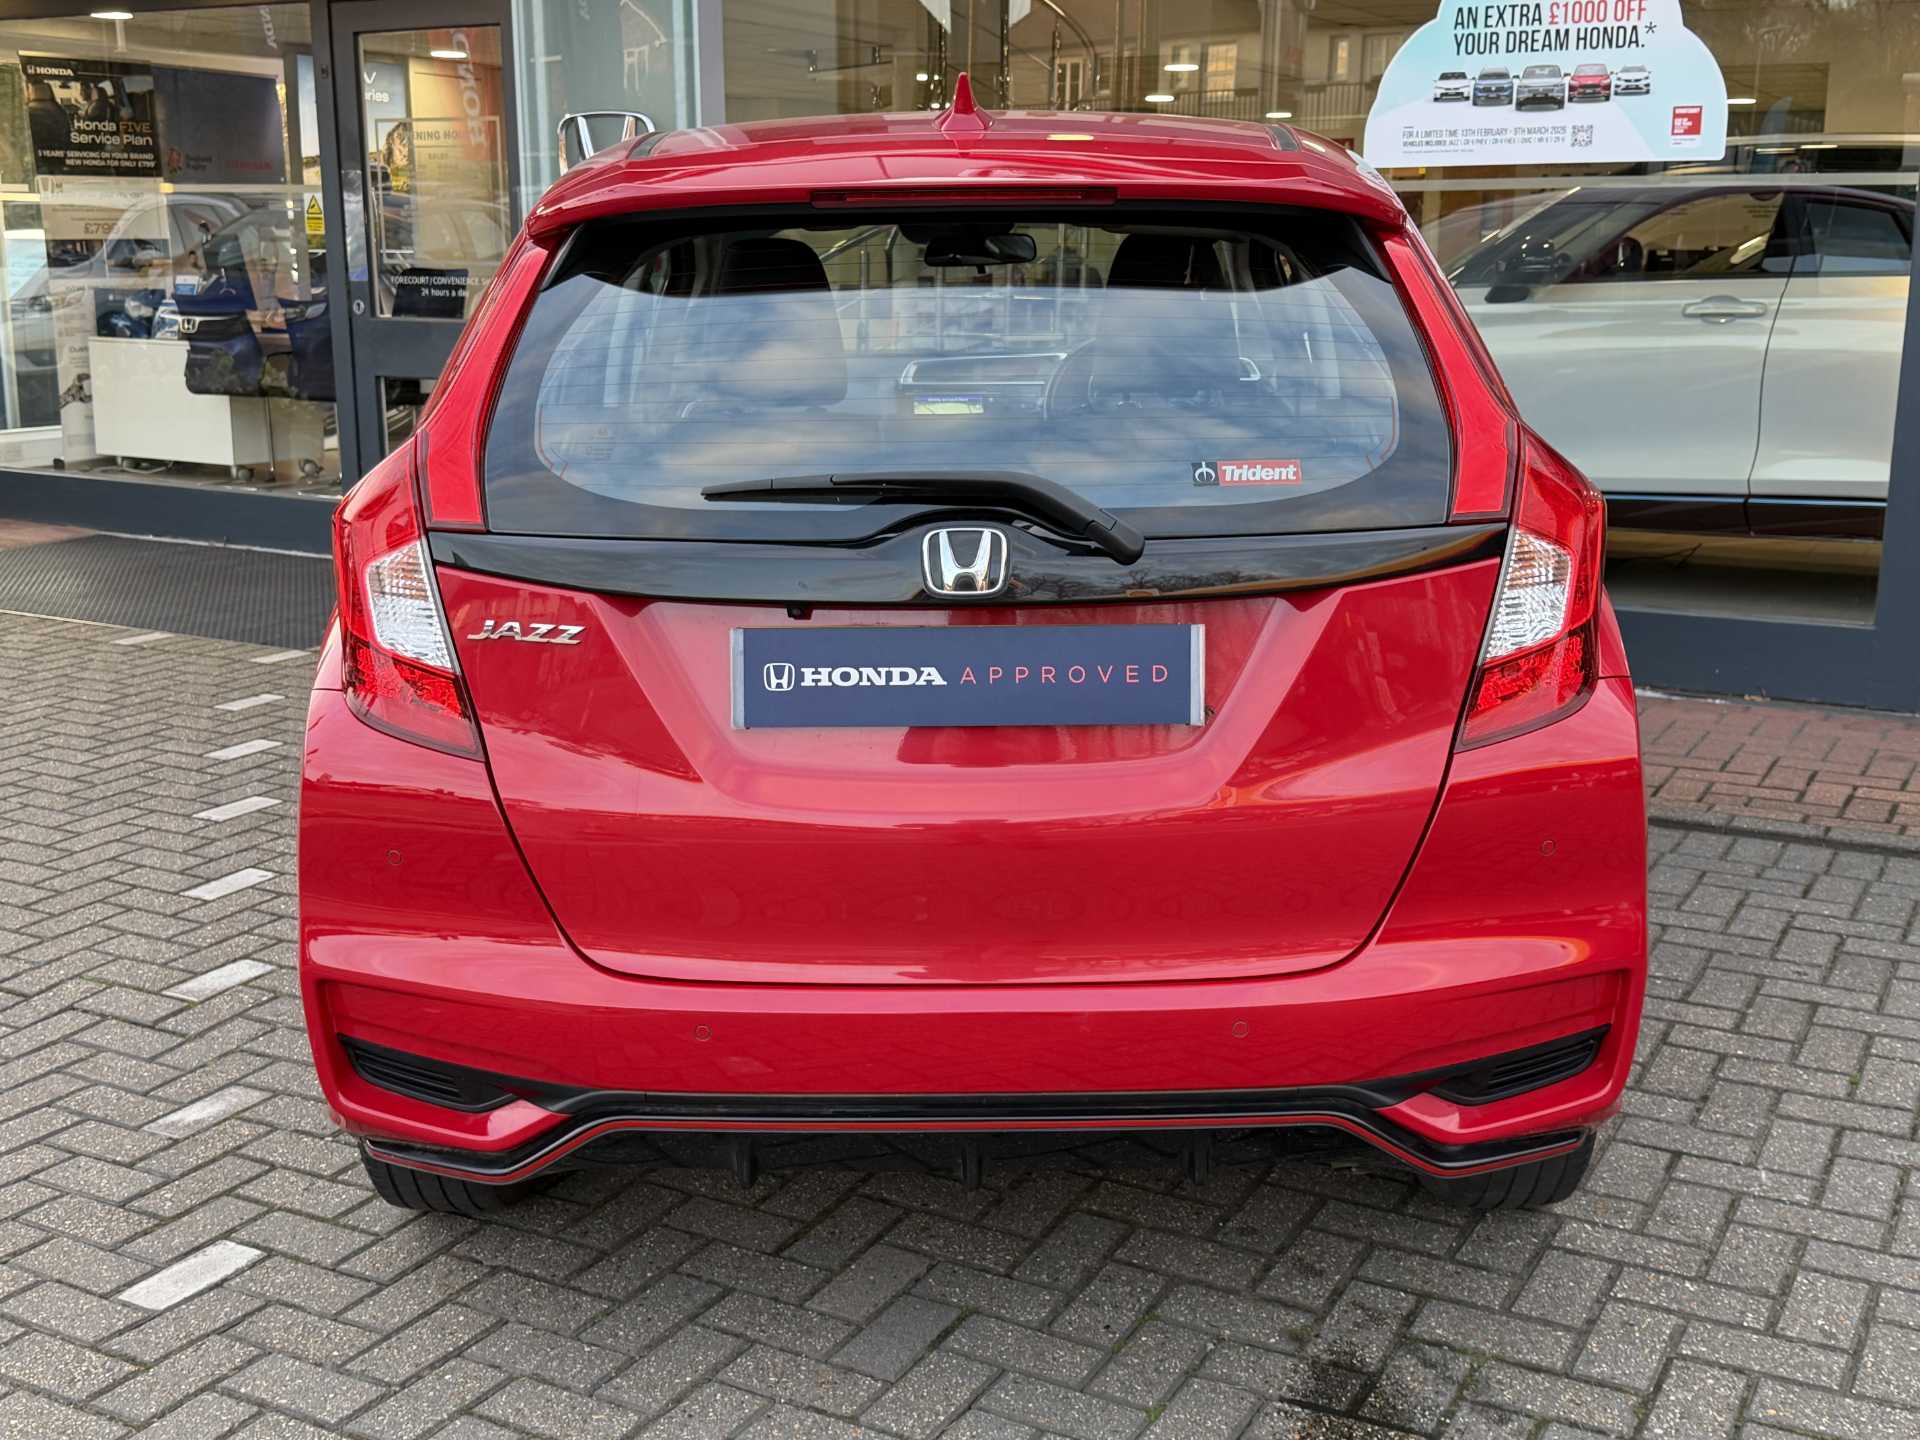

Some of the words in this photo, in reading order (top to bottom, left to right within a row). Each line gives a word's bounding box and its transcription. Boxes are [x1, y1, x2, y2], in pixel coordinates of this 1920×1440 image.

[1454, 6, 1479, 30] AN
[1484, 3, 1543, 28] EXTRA
[1548, 0, 1608, 25] £1000
[1613, 0, 1647, 22] OFF
[1454, 31, 1500, 56] YOUR
[1505, 29, 1570, 54] DREAM
[36, 65, 74, 77] HONDA
[73, 119, 117, 131] Honda
[119, 121, 153, 133] FIVE
[70, 132, 120, 145] Service
[122, 133, 153, 146] Plan
[66, 149, 101, 159] SERVICING
[111, 151, 129, 160] YOUR
[129, 152, 154, 161] BRAND
[431, 287, 450, 298] hours
[1221, 463, 1297, 482] Trident
[466, 619, 586, 645] JAZZ
[800, 666, 948, 688] HONDA
[959, 664, 1169, 686] APPROVED
